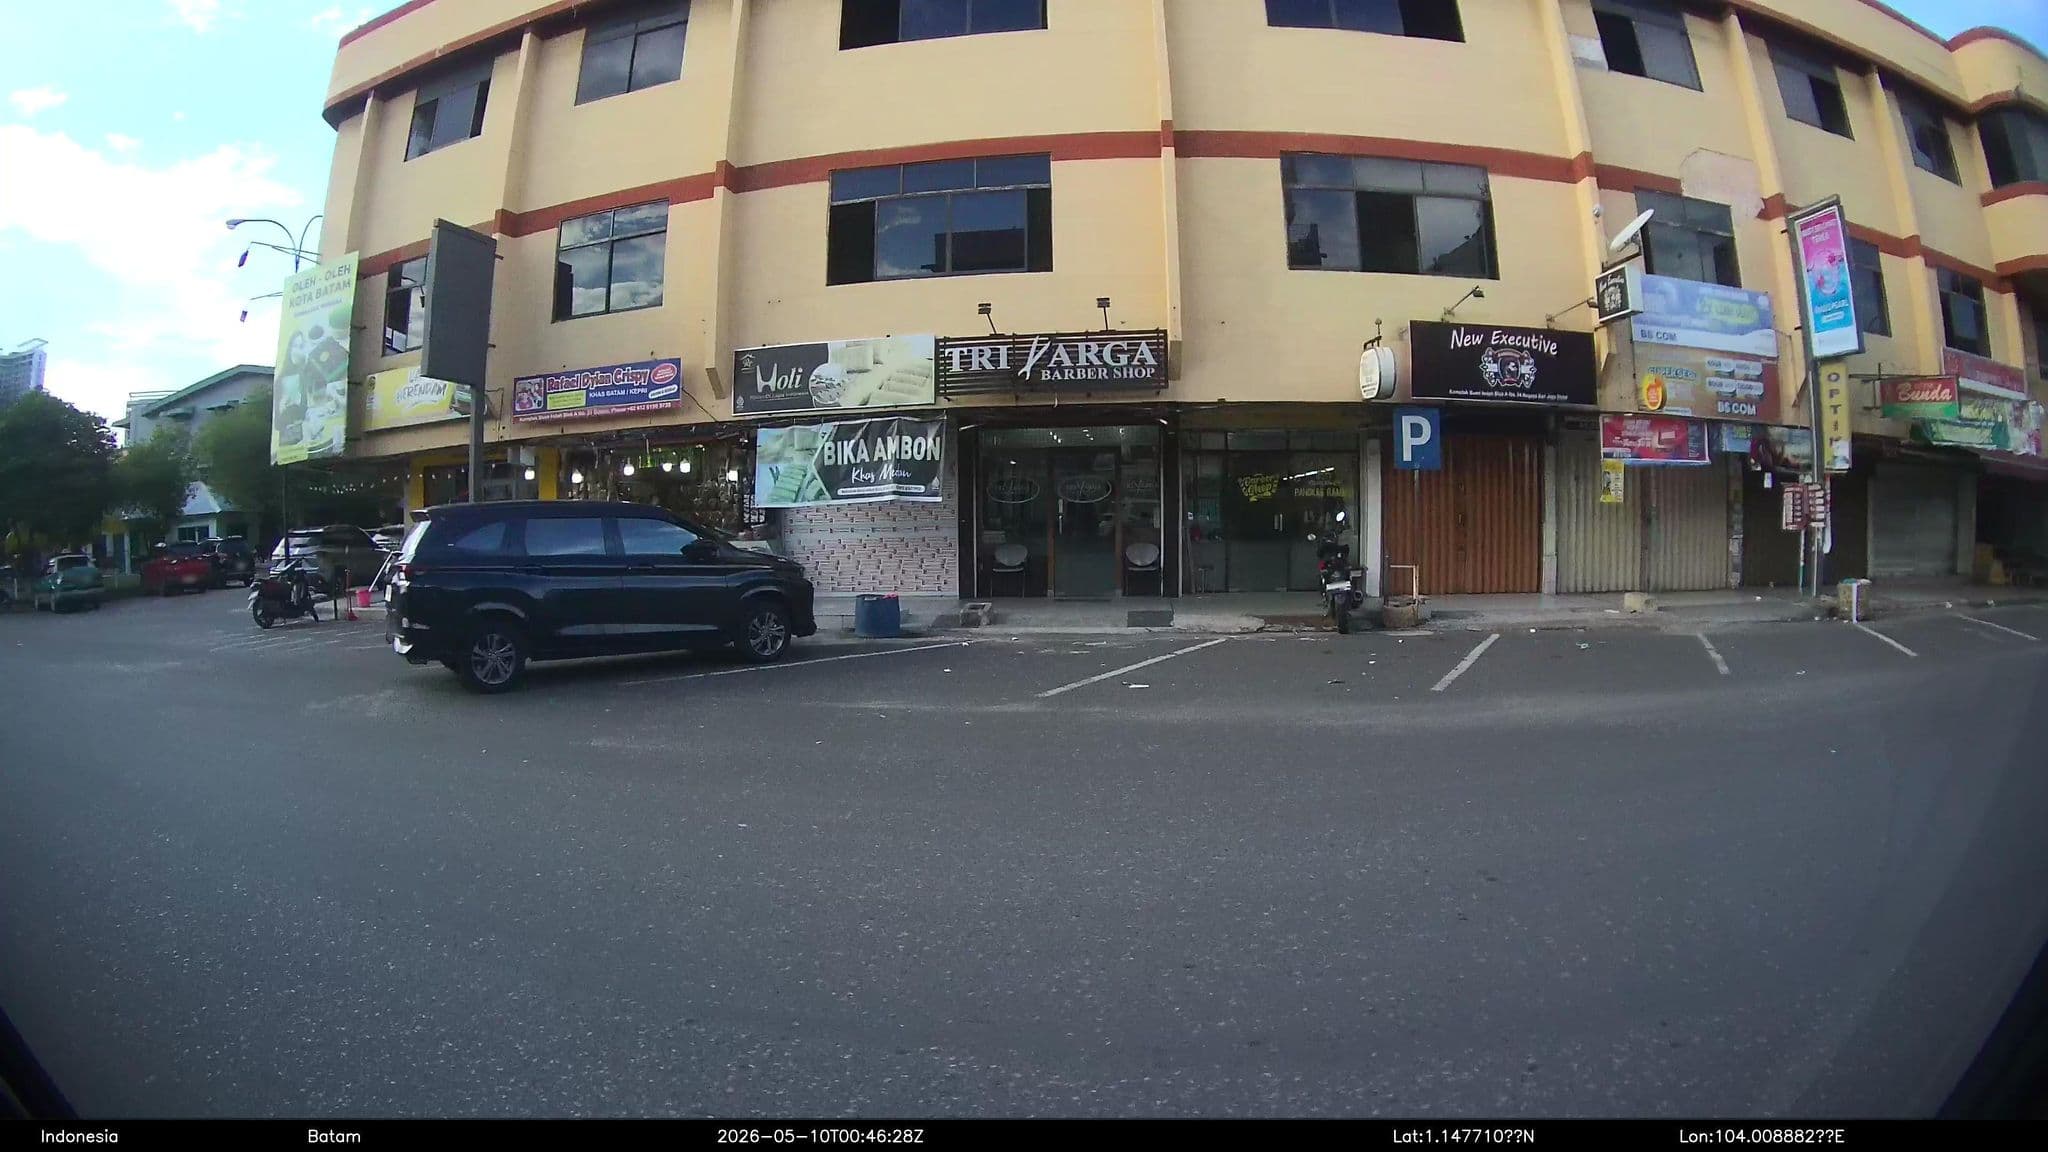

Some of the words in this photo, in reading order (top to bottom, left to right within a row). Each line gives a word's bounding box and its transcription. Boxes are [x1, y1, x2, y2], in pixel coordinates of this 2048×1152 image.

[293, 276, 316, 293] OLEH
[325, 264, 351, 281] OLEH
[289, 291, 313, 308] KOTA
[315, 280, 351, 299] BATAM
[1450, 327, 1483, 350] New
[1491, 330, 1557, 355] Executive
[1656, 331, 1677, 340] COM
[945, 346, 1011, 371] TRI
[547, 377, 580, 392] Rafael
[613, 367, 650, 385] Crispy
[756, 363, 803, 393] Holi
[1041, 368, 1109, 381] BARBER
[1113, 367, 1154, 379] SHOP
[1897, 382, 1952, 401] Bunda
[1732, 403, 1756, 416] COM
[824, 435, 870, 466] BIKA
[873, 435, 941, 463] AMBON
[1401, 415, 1431, 461] P
[851, 466, 875, 484] Khas
